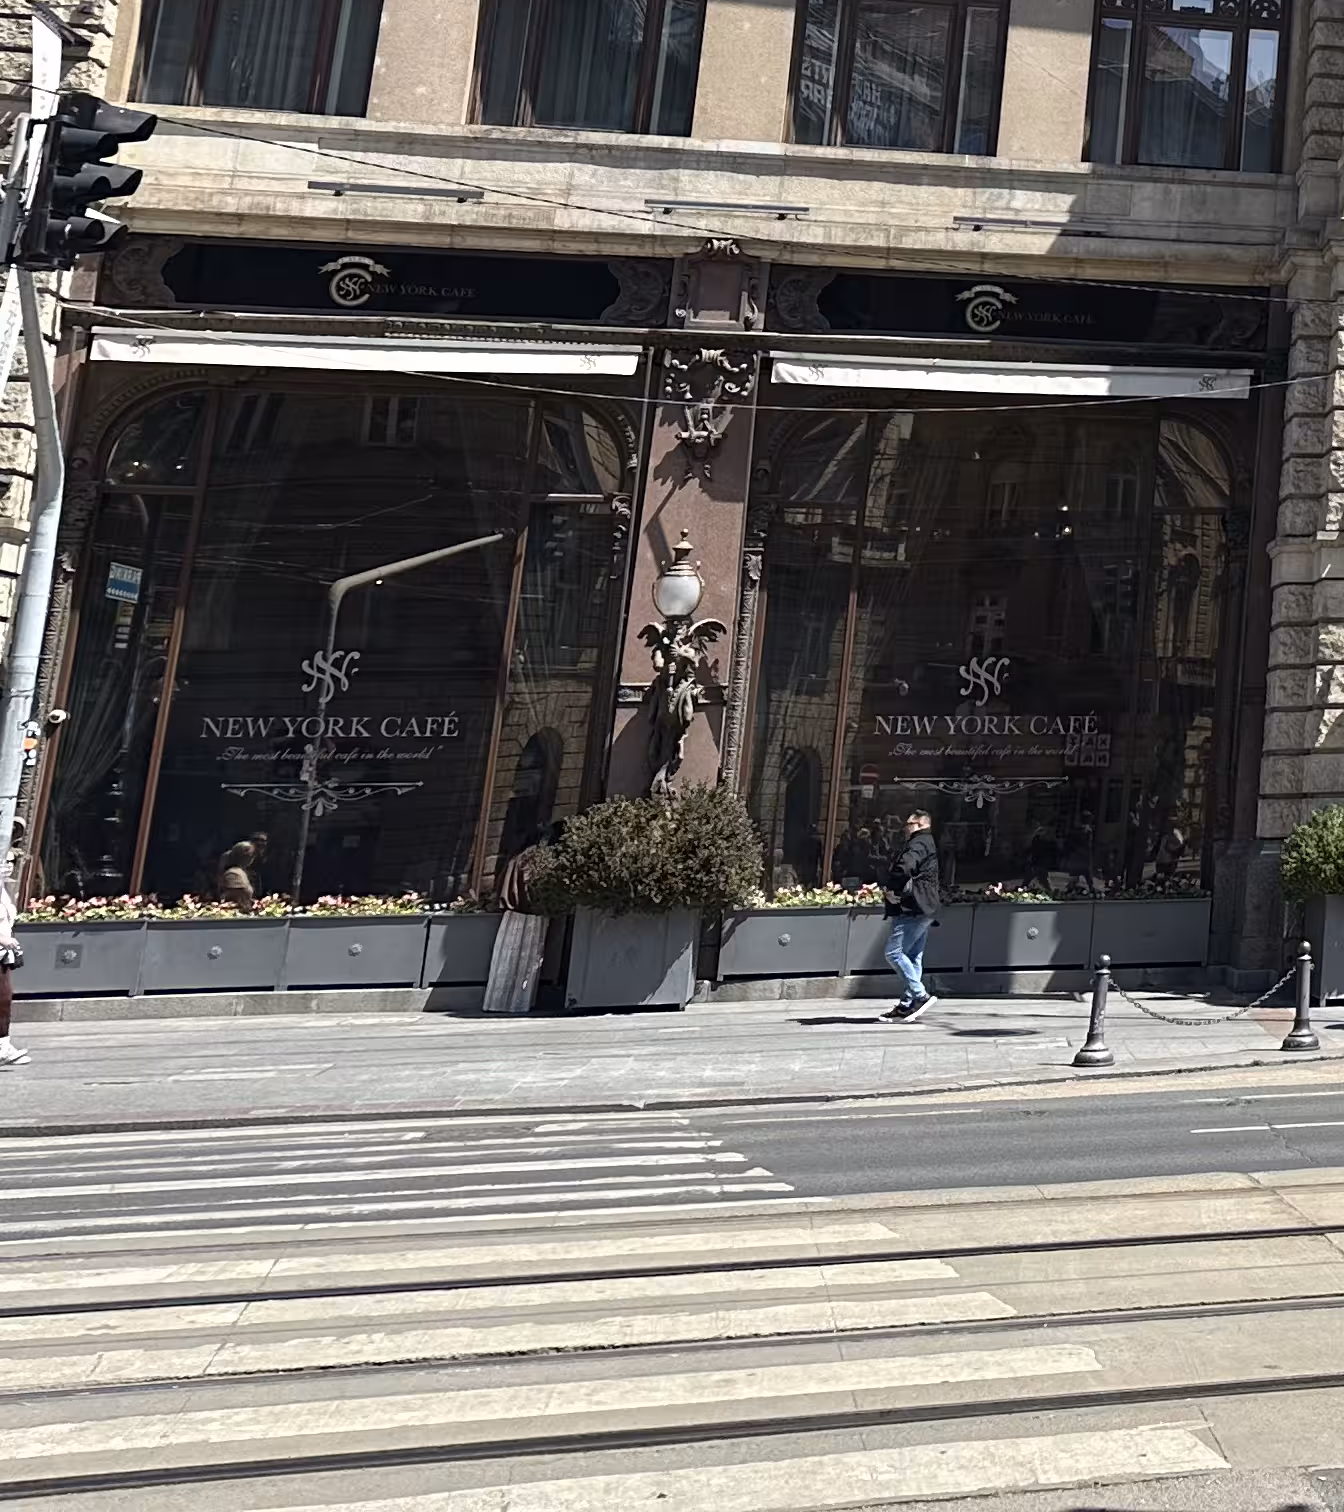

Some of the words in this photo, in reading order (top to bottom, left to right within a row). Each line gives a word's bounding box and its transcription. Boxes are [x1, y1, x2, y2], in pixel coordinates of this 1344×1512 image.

[200, 717, 276, 738] NEW
[282, 716, 373, 738] YORK
[379, 711, 459, 738] CAFÉ
[873, 715, 938, 735] NEW
[944, 715, 1022, 735] YORK
[1029, 710, 1099, 735] CAFÉ
[251, 749, 281, 761] most
[361, 750, 375, 760] in
[376, 748, 396, 760] the
[919, 746, 944, 757] most
[1027, 744, 1043, 756] the
